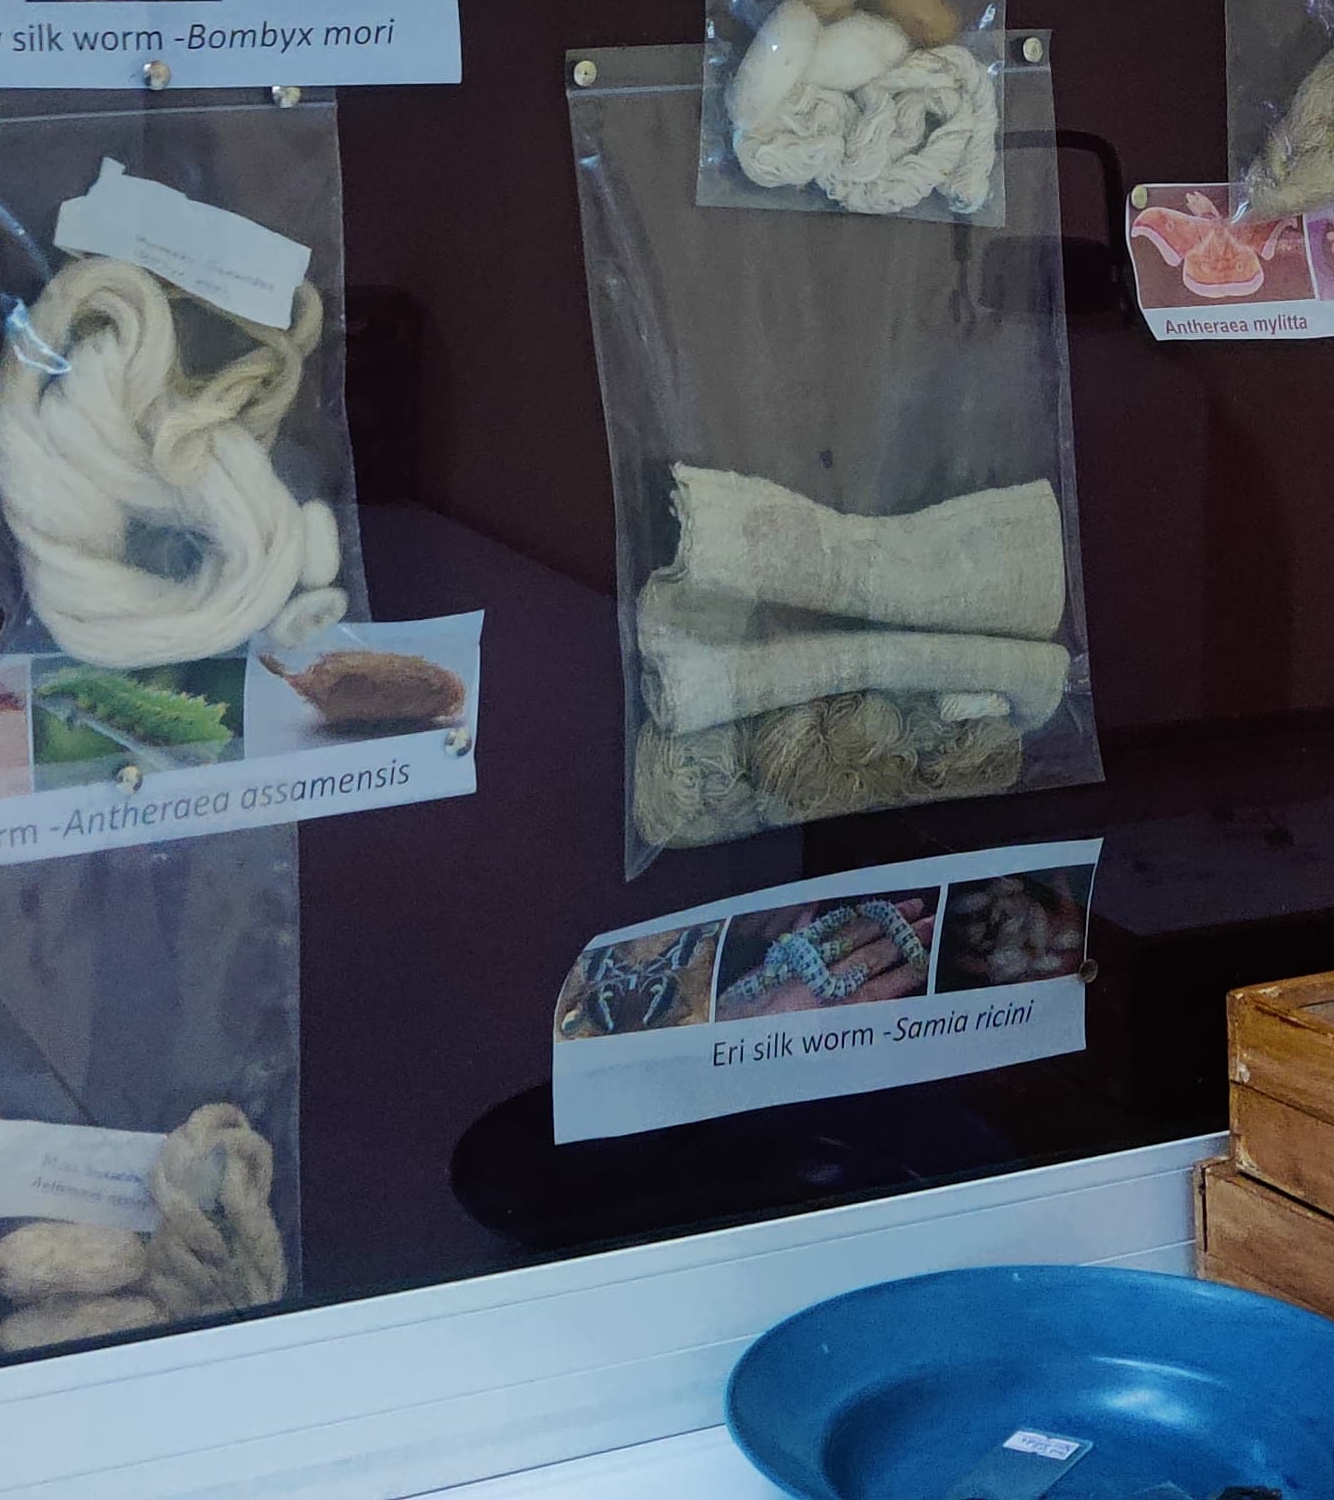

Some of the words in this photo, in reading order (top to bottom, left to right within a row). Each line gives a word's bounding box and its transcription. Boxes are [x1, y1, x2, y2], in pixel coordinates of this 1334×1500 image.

[12, 23, 62, 52] silk
[73, 29, 164, 52] worm
[174, 20, 313, 53] -Bombyx
[324, 18, 395, 47] mori
[1166, 320, 1249, 334] Antheraea
[1253, 314, 1308, 335] mylitta
[49, 790, 232, 840] -Antheraea
[239, 757, 411, 810] assamensis
[713, 1040, 745, 1067] Eri
[753, 1031, 793, 1062] silk
[802, 1023, 874, 1054] worm
[882, 1012, 969, 1044] -Samia
[975, 999, 1034, 1030] ricini
